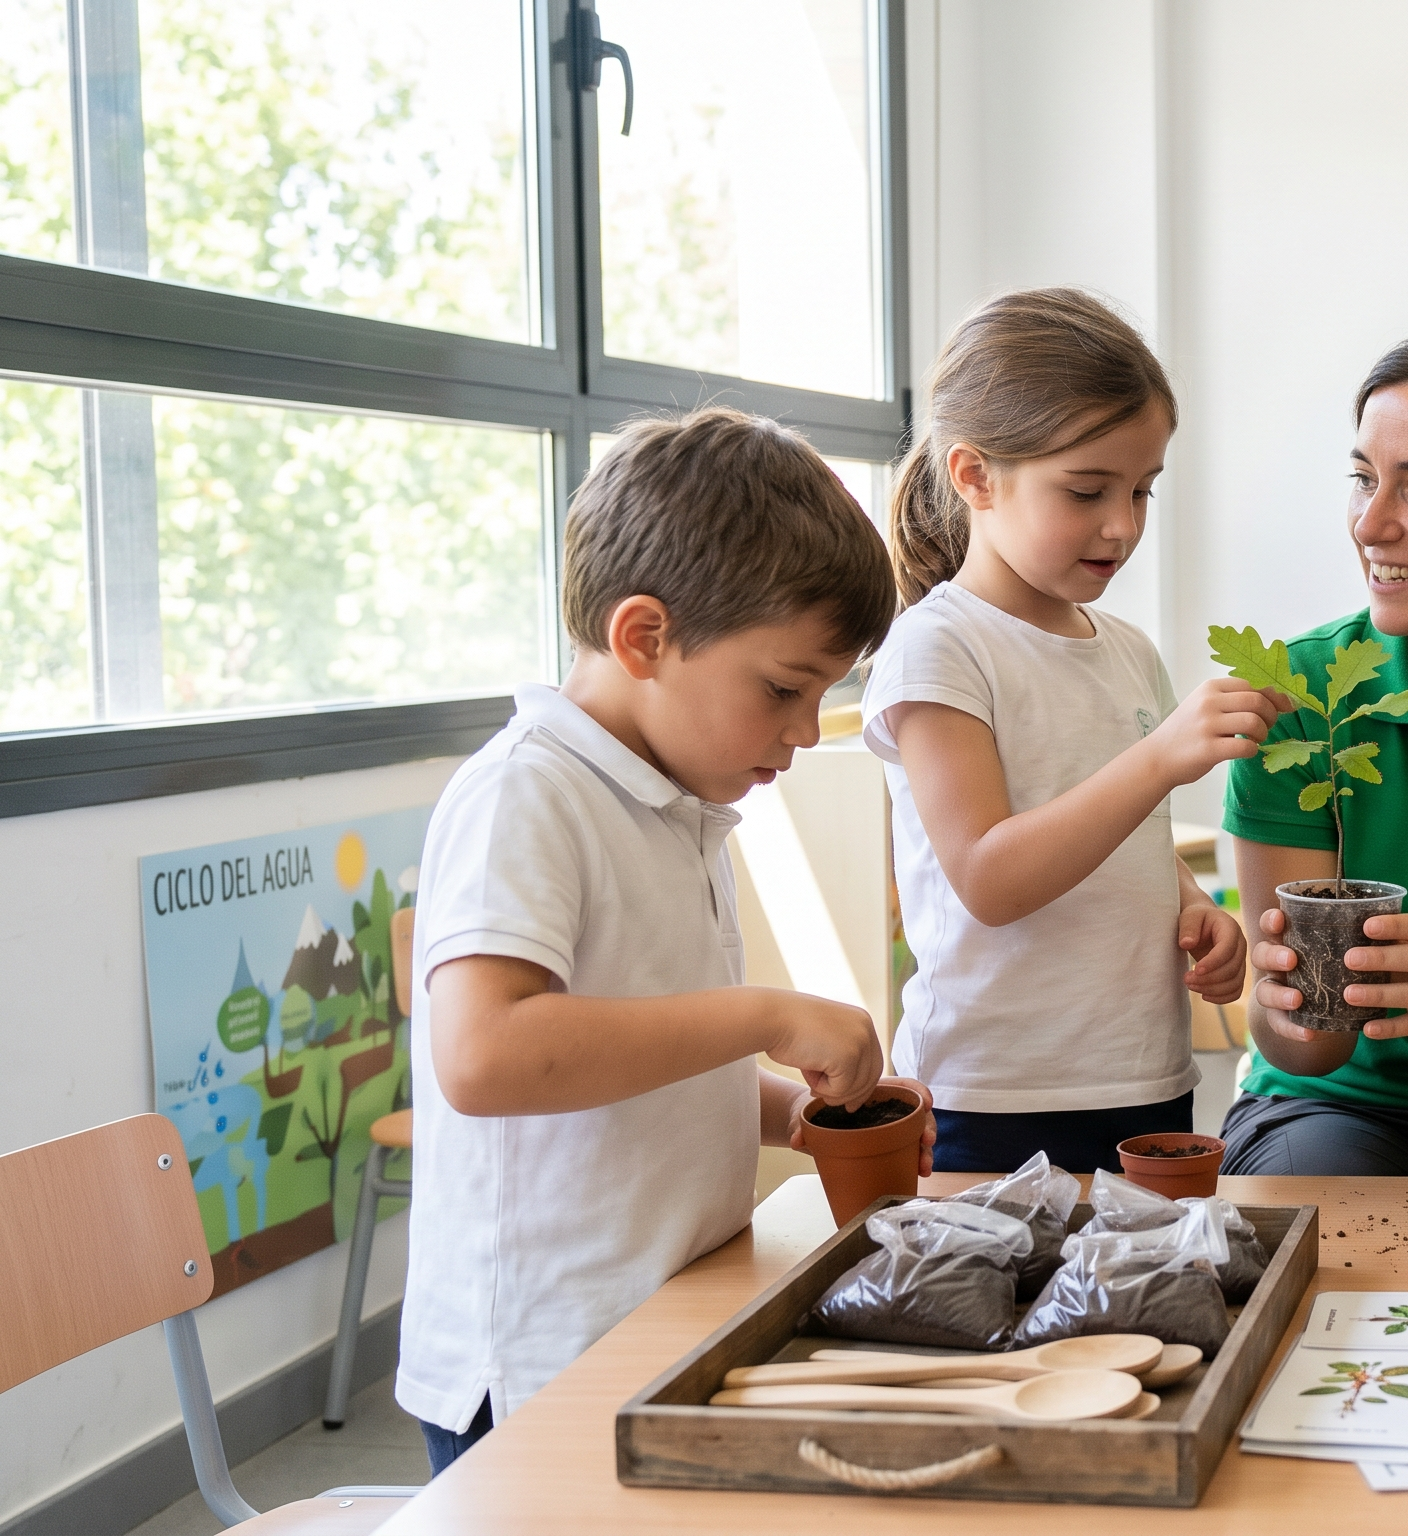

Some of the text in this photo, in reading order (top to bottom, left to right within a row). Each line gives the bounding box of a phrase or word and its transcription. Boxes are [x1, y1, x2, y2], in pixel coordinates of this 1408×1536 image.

[153, 846, 314, 916] CICLO DEL AGUA
